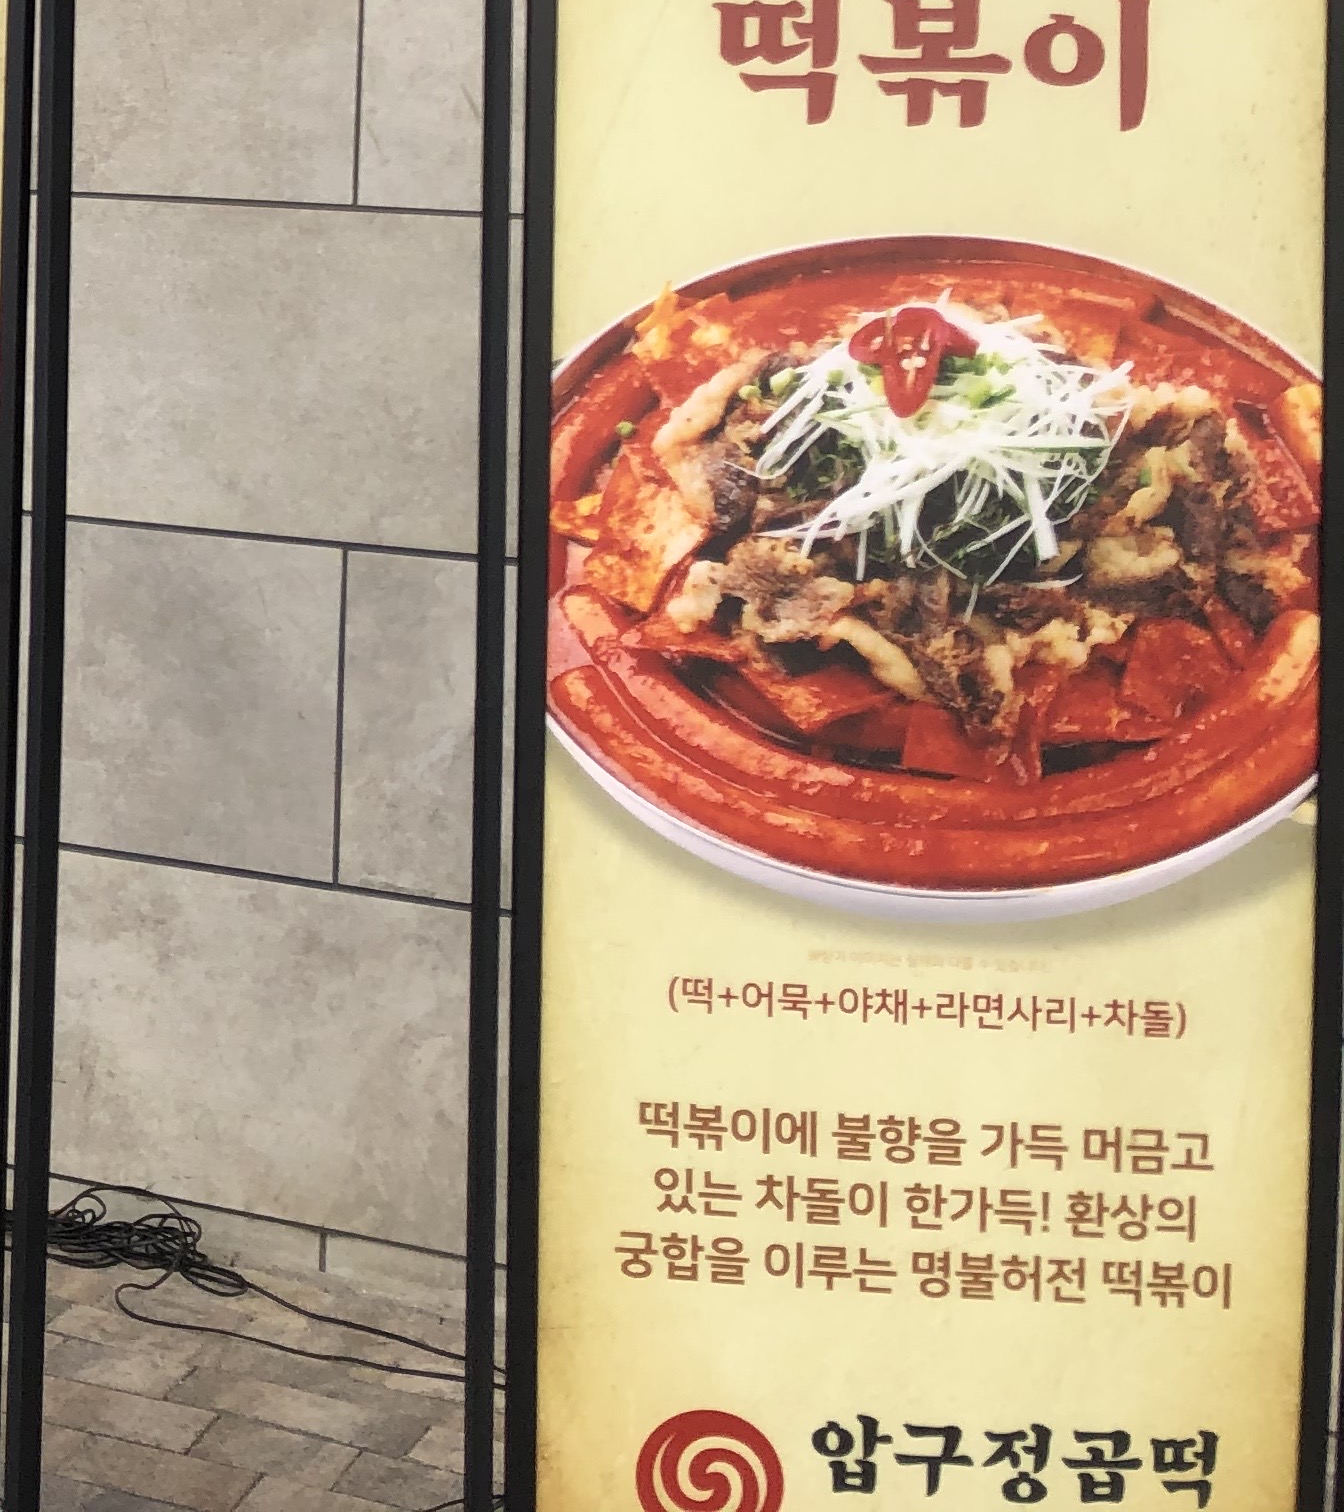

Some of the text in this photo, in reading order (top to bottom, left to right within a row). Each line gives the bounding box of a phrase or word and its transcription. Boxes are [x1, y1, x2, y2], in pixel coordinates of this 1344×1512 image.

[667, 976, 1188, 1041] (떡+어묵+야채+라면사리+차돌)
[637, 1101, 1216, 1177] 떡볶이에 불향을 가득 머금고
[652, 1167, 1198, 1244] 있는 차돌이 한가득! 환상의
[615, 1231, 1233, 1310] 궁합을 이루는 명불허전 떡볶이
[812, 1413, 1222, 1510] 압구정곱떡
